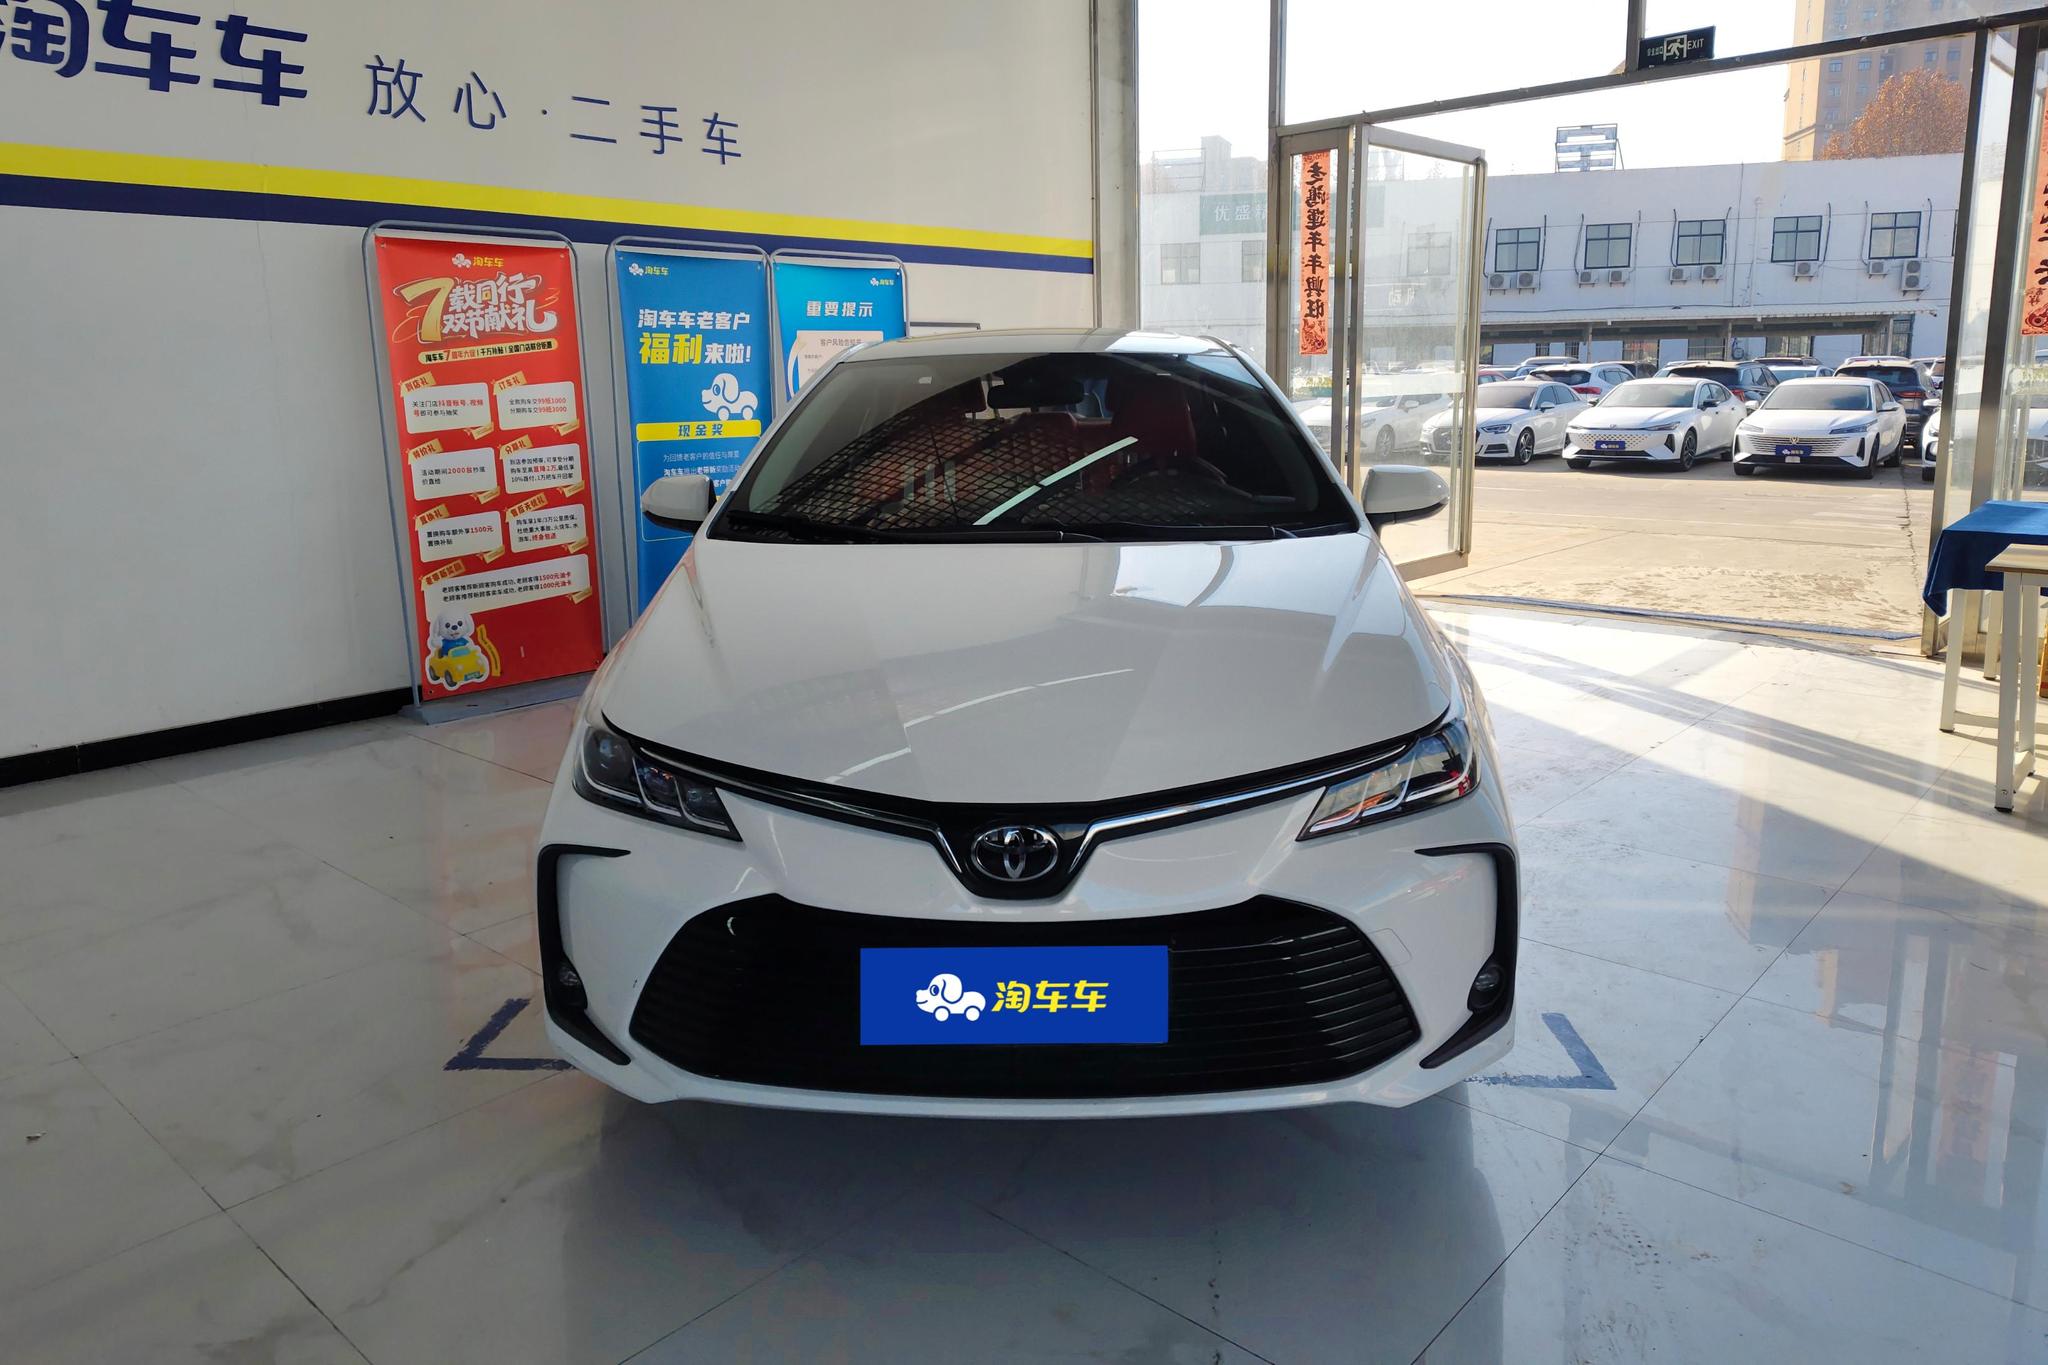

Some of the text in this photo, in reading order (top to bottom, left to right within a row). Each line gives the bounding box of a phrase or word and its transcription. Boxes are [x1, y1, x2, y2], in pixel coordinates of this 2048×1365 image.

[1687, 38, 1704, 49] EXIT
[366, 55, 742, 165] 放心·二手车
[473, 256, 504, 268] 淘车车
[806, 300, 873, 317] 重要提示
[638, 309, 750, 330] 淘车车老客户
[678, 424, 724, 437] 现金奖
